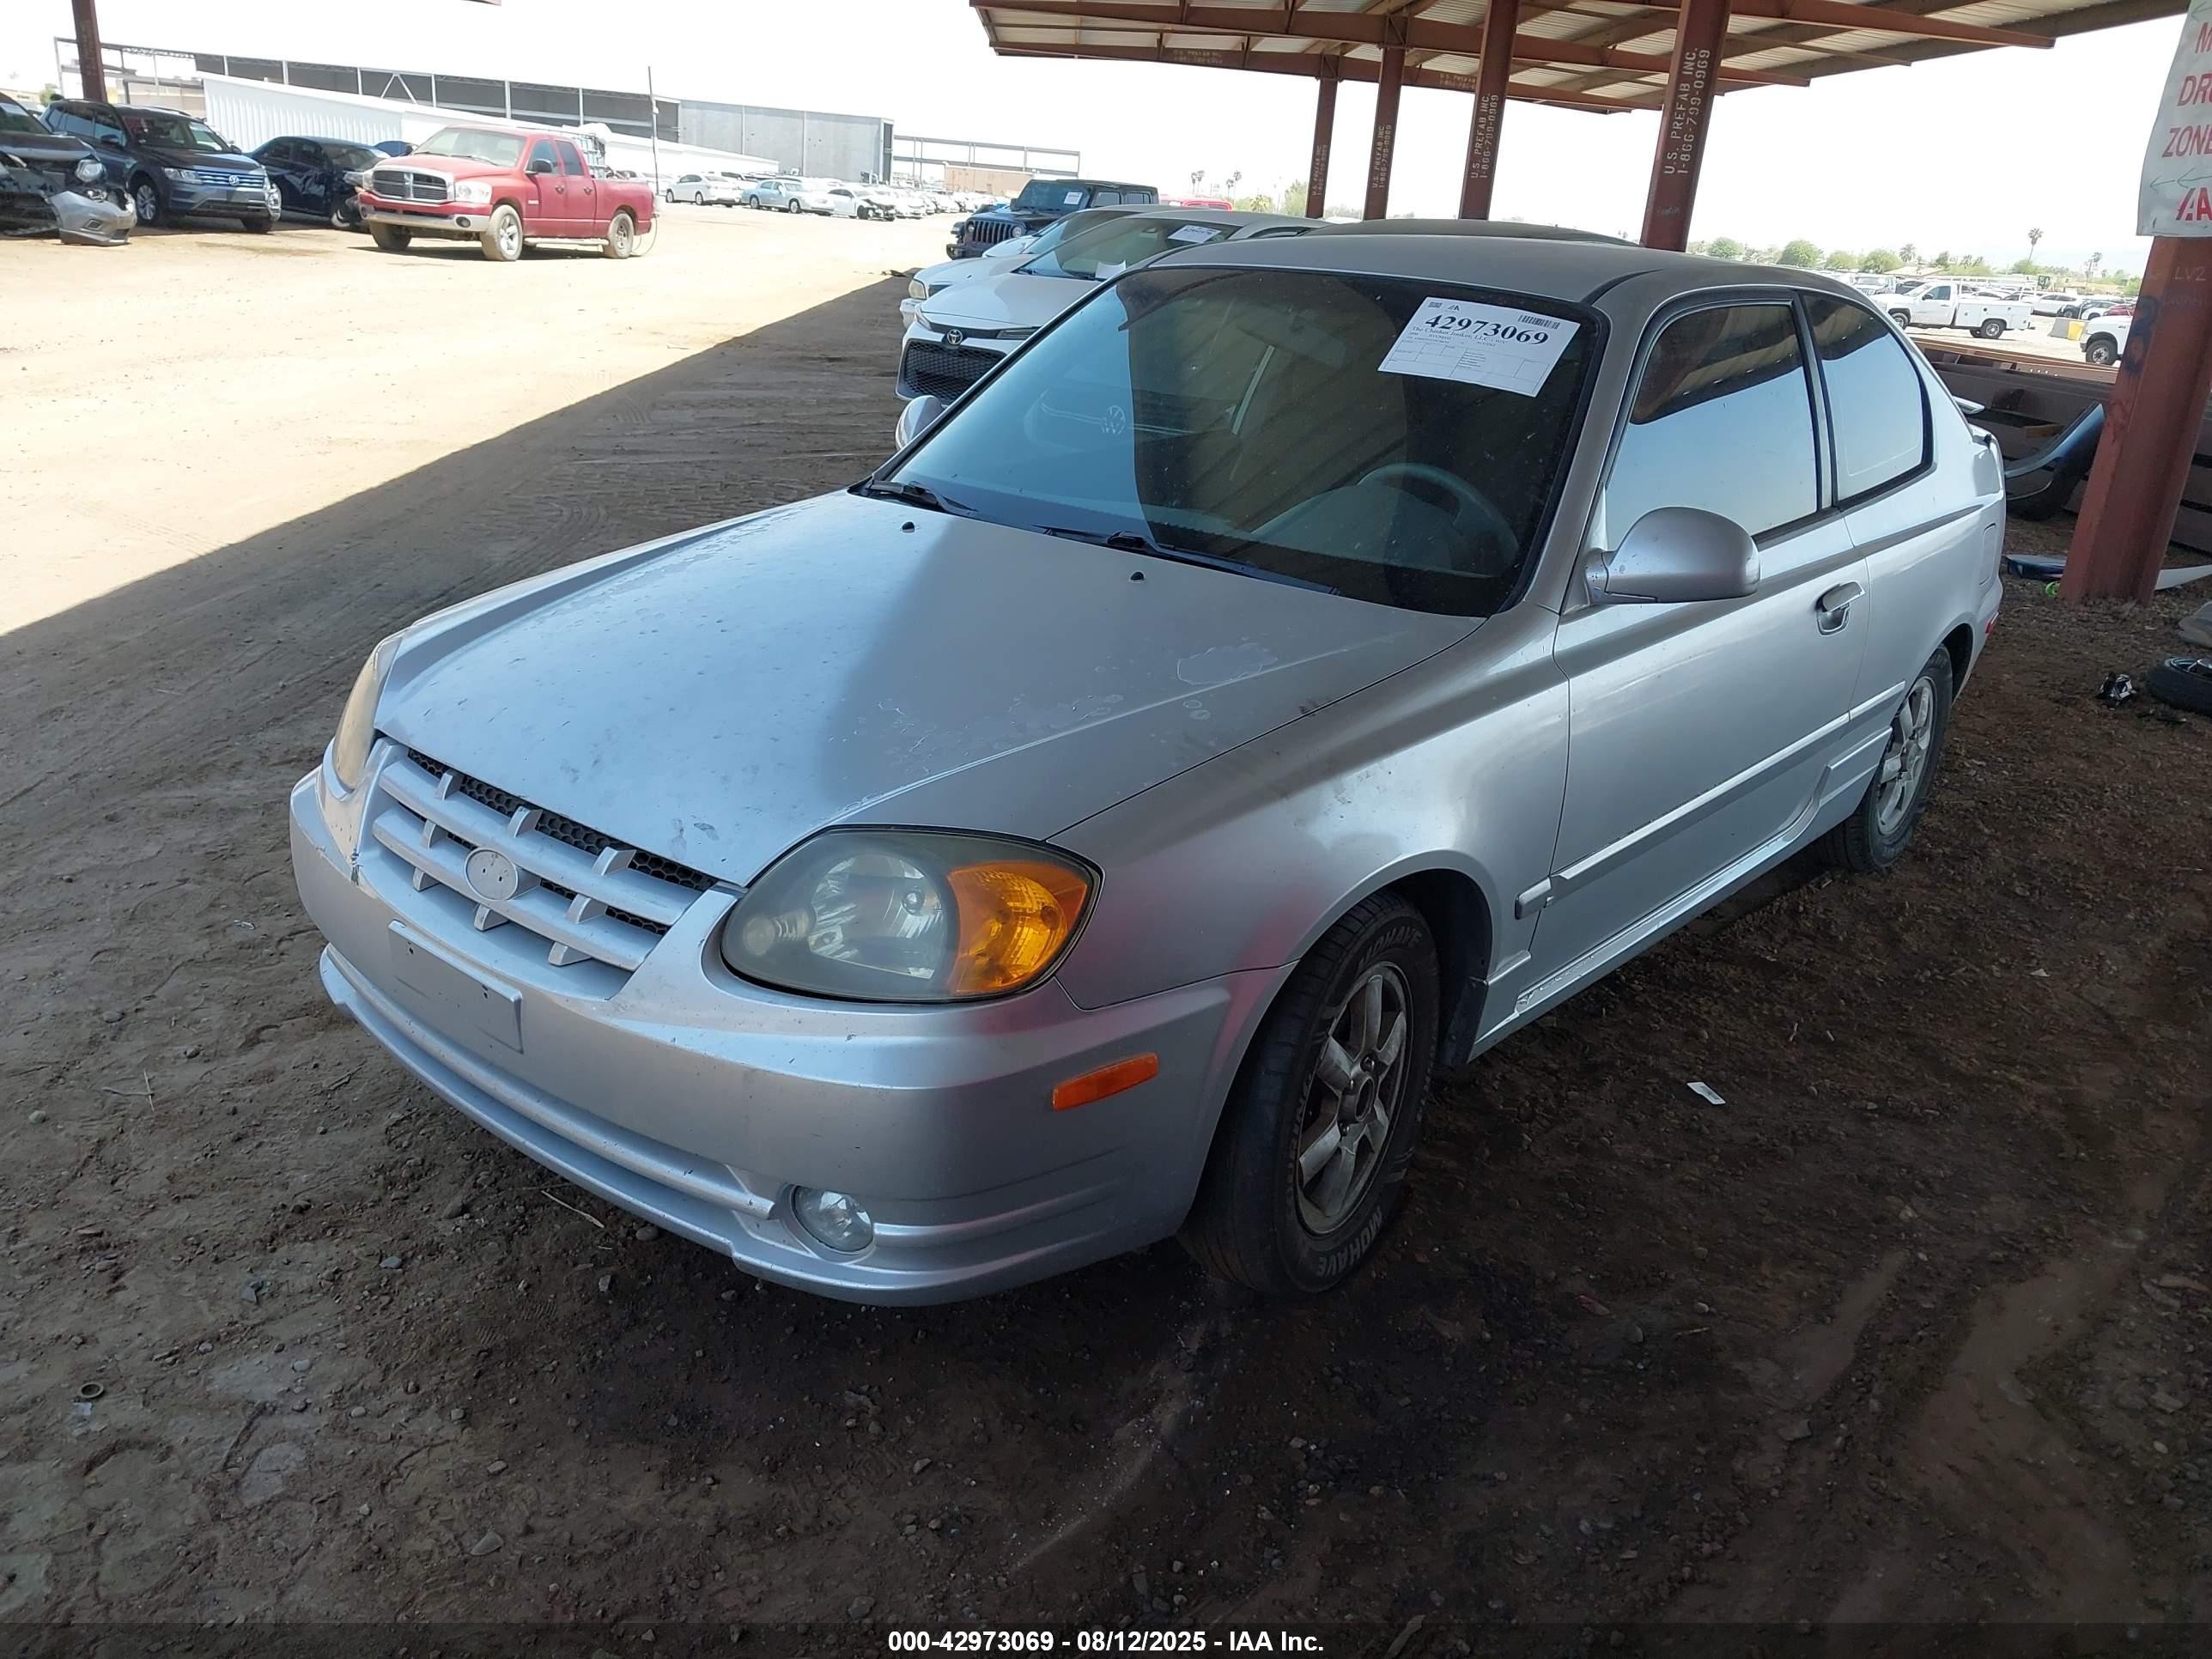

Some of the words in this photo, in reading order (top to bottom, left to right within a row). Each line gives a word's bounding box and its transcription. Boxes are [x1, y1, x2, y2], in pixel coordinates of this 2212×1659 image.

[1682, 47, 1698, 76] INC.
[2177, 73, 2212, 106] DR
[1670, 82, 1691, 139] PREFAB
[1677, 49, 1711, 174] 1-866-799-0969
[1474, 117, 1486, 155] PREFAB
[1663, 148, 1680, 174] U.S.
[1425, 314, 1549, 345] 42973069
